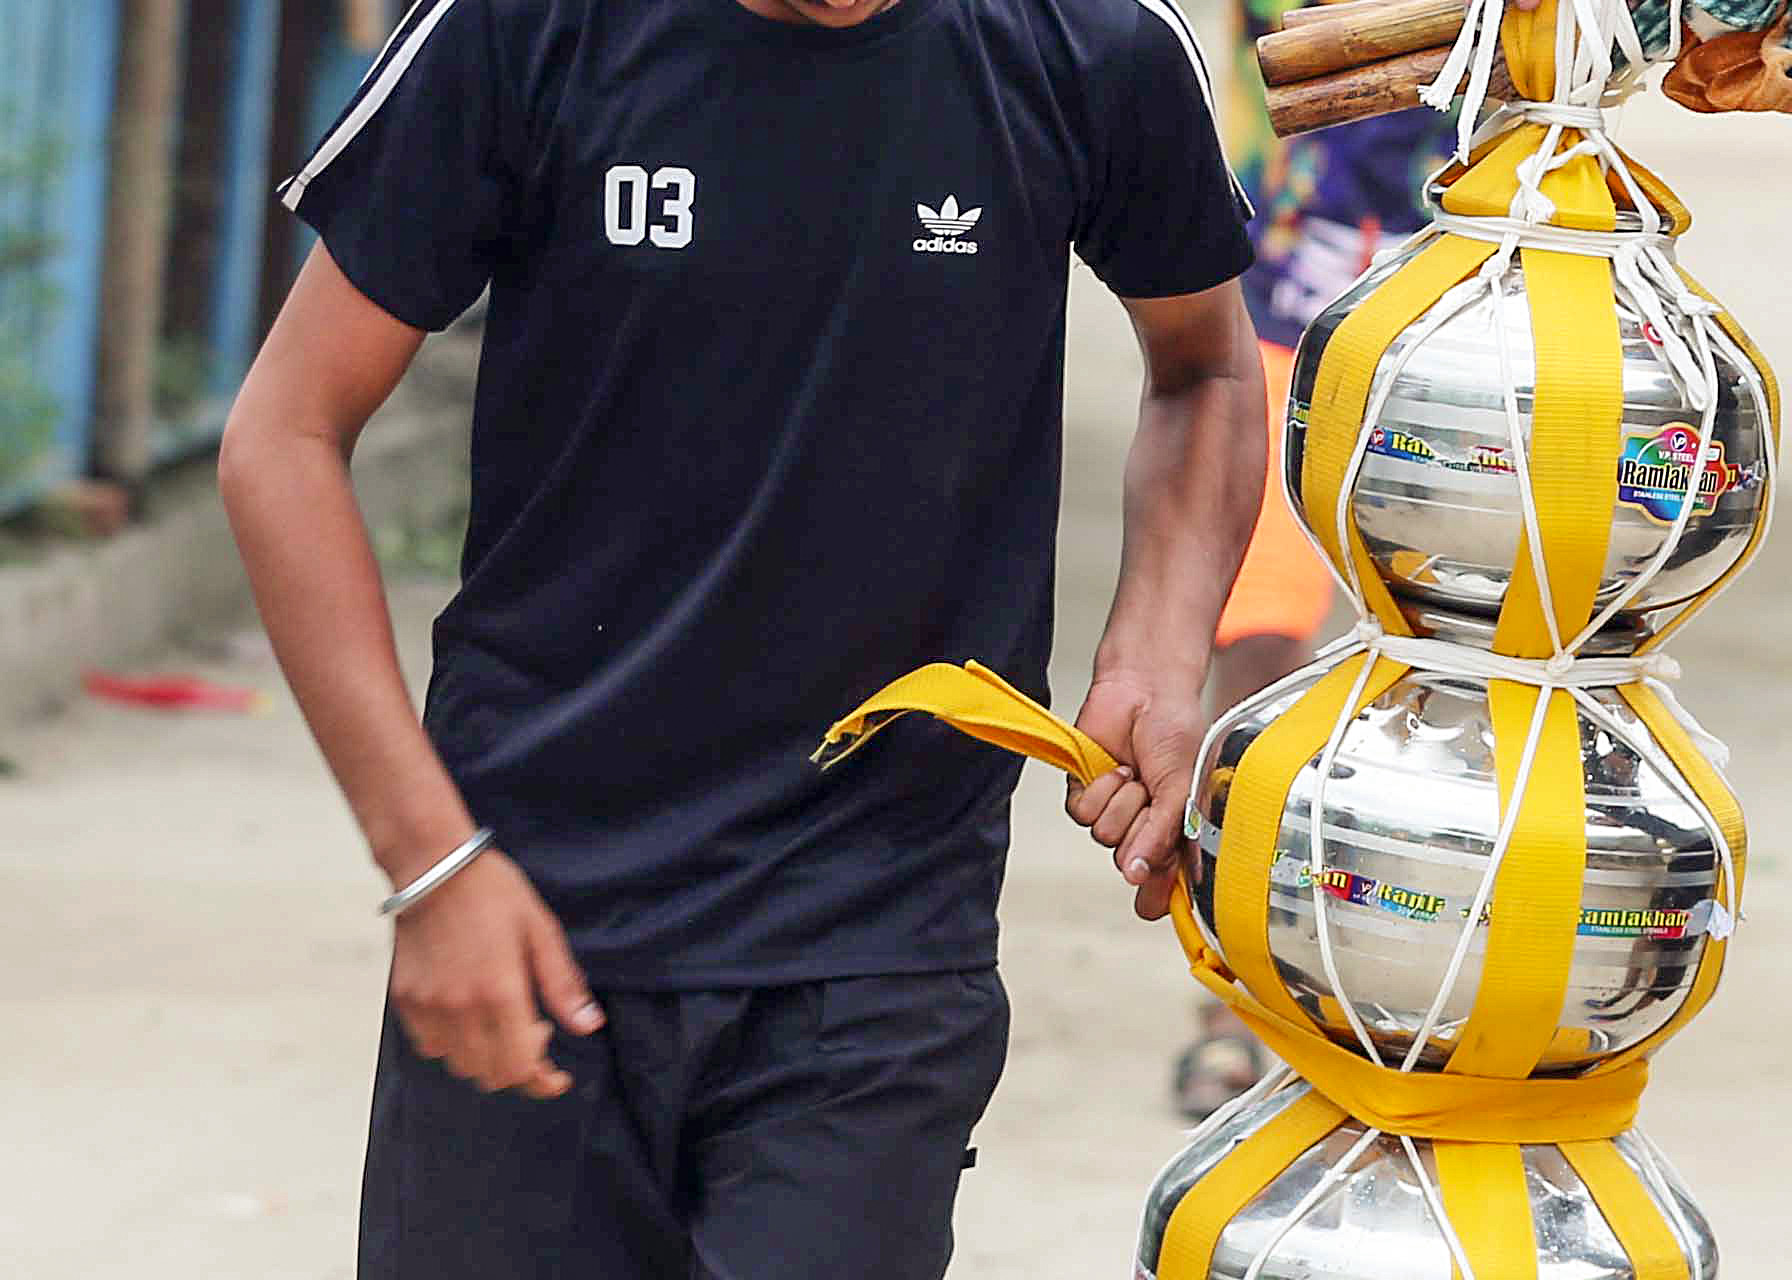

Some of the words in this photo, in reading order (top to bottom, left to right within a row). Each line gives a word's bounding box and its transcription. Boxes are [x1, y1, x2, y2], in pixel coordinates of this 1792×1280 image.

[605, 165, 696, 249] 03
[913, 237, 978, 254] adidas
[1622, 459, 1717, 493] Ramlakan
[1580, 908, 1687, 927] amlakhan
